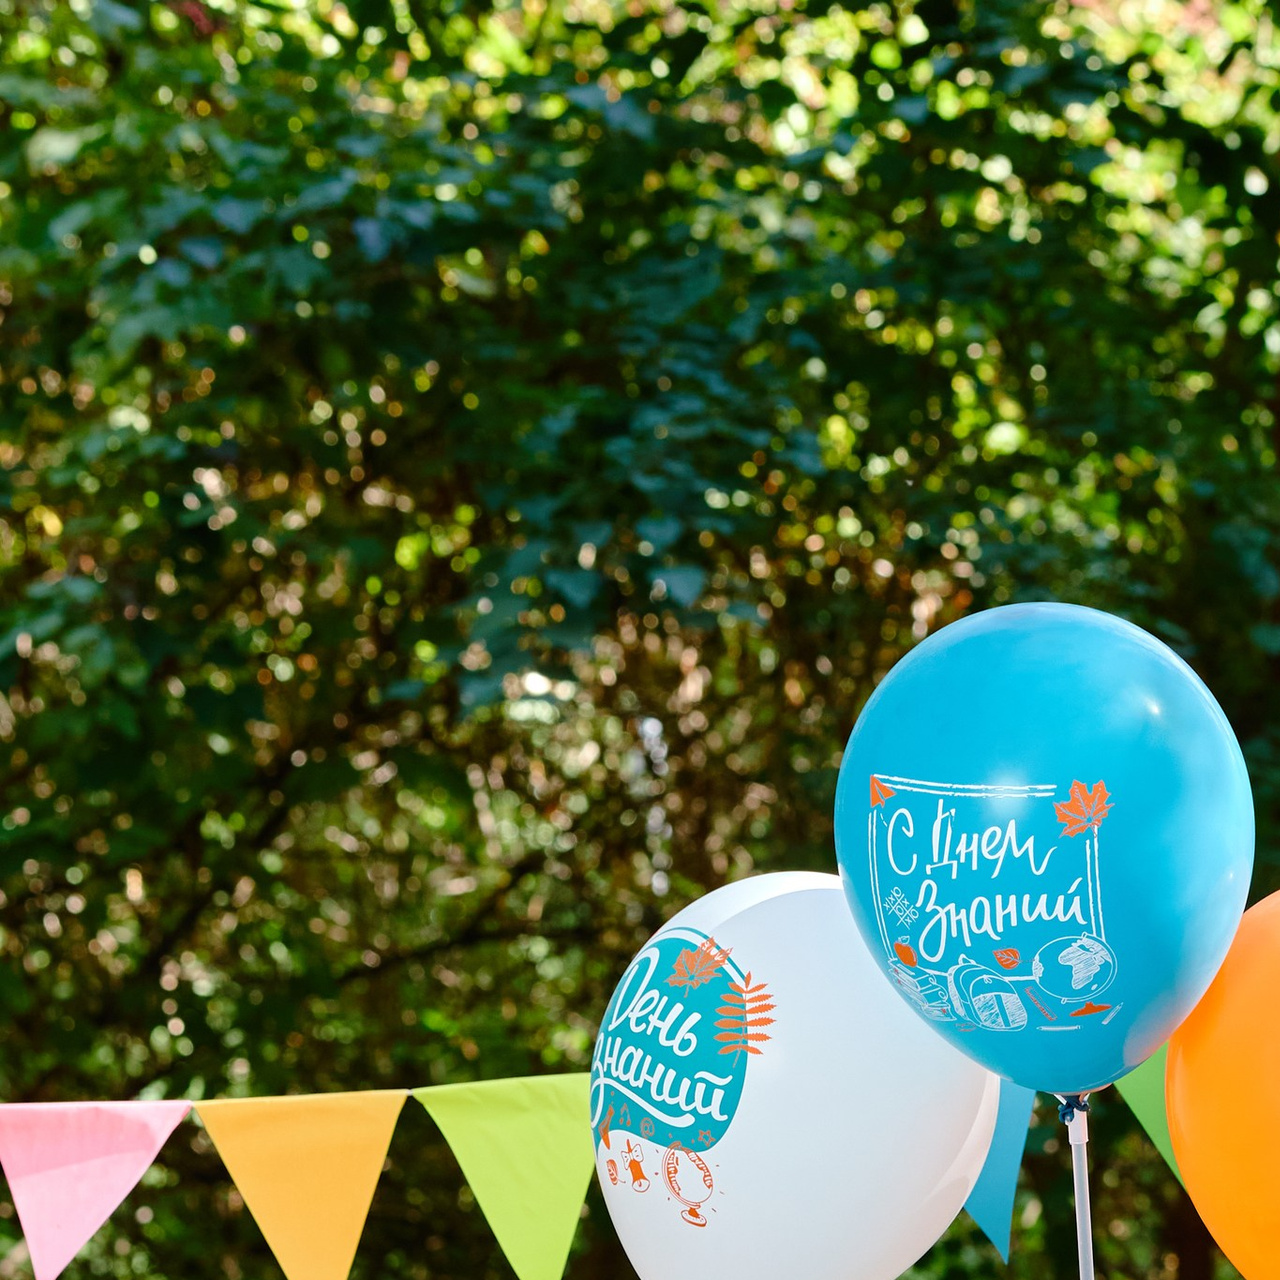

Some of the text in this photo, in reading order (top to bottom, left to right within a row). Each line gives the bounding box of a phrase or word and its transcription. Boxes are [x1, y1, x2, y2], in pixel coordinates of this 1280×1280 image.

[887, 807, 918, 876] С
[915, 877, 1088, 963] Знаний
[607, 946, 702, 1057] День
